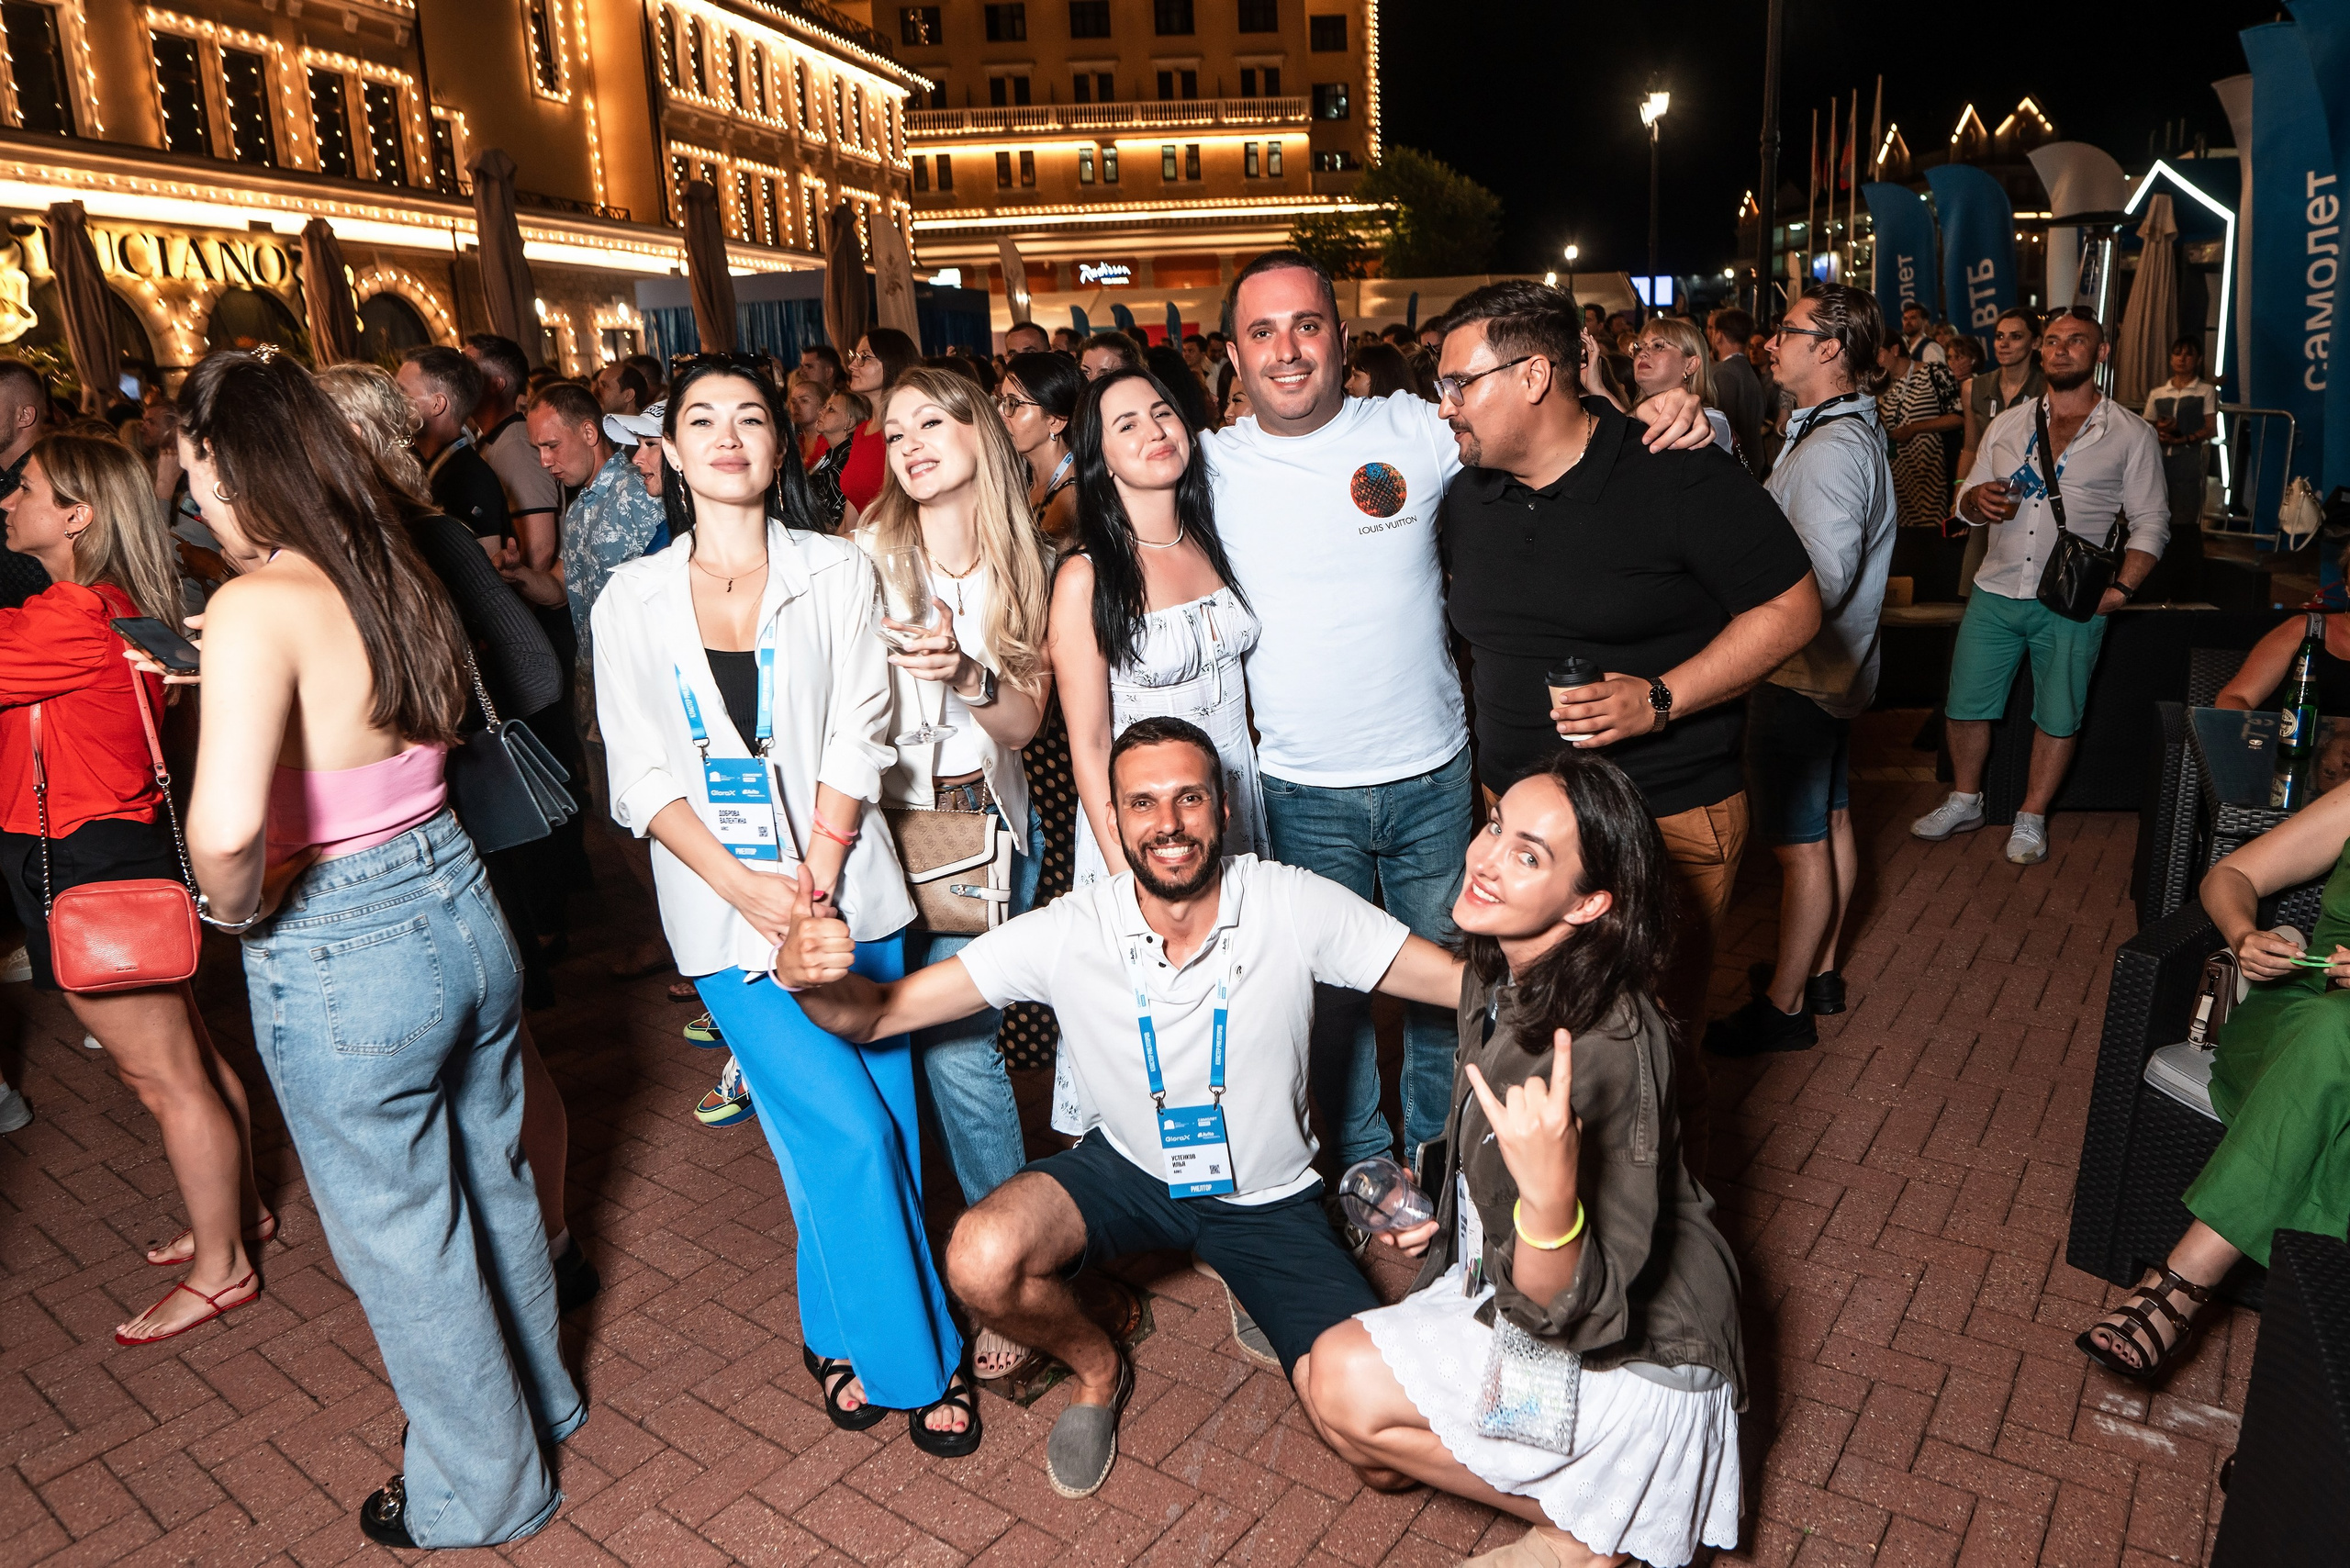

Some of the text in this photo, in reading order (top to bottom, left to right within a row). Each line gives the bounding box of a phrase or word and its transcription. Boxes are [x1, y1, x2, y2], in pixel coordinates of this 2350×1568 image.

[1897, 254, 1916, 311] олет
[2304, 171, 2340, 392] самолет
[1966, 258, 1998, 329] ВТБ
[1359, 515, 1417, 534] LOUIS VUITTON
[1165, 1134, 1191, 1143] GloraX
[1171, 1153, 1196, 1161] УСТЕНКОВ
[1191, 1183, 1213, 1193] РИЕЛТОР
